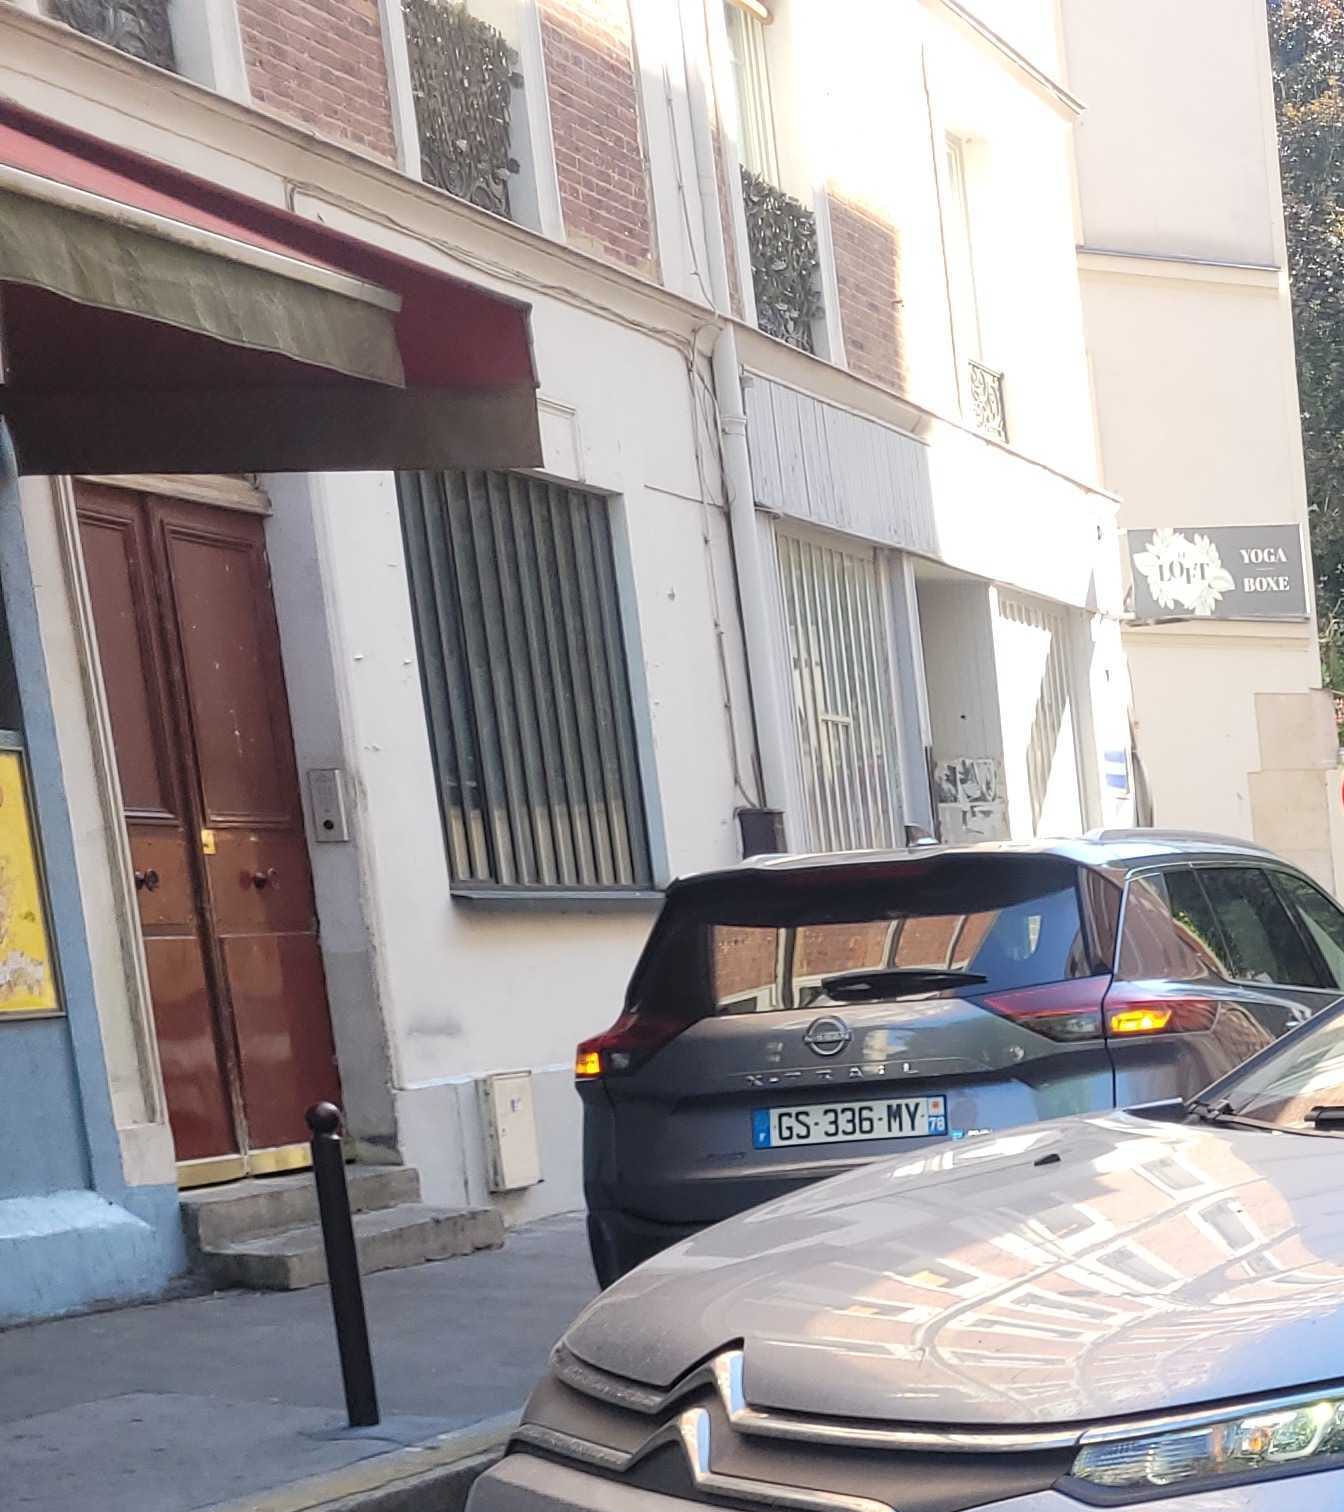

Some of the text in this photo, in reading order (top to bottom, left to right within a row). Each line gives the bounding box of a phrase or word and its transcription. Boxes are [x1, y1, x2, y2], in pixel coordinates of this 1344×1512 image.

[1240, 547, 1288, 565] YOGA
[1243, 576, 1290, 593] BOXE
[777, 1102, 922, 1141] GS-336-MY
[927, 1115, 945, 1132] 78
